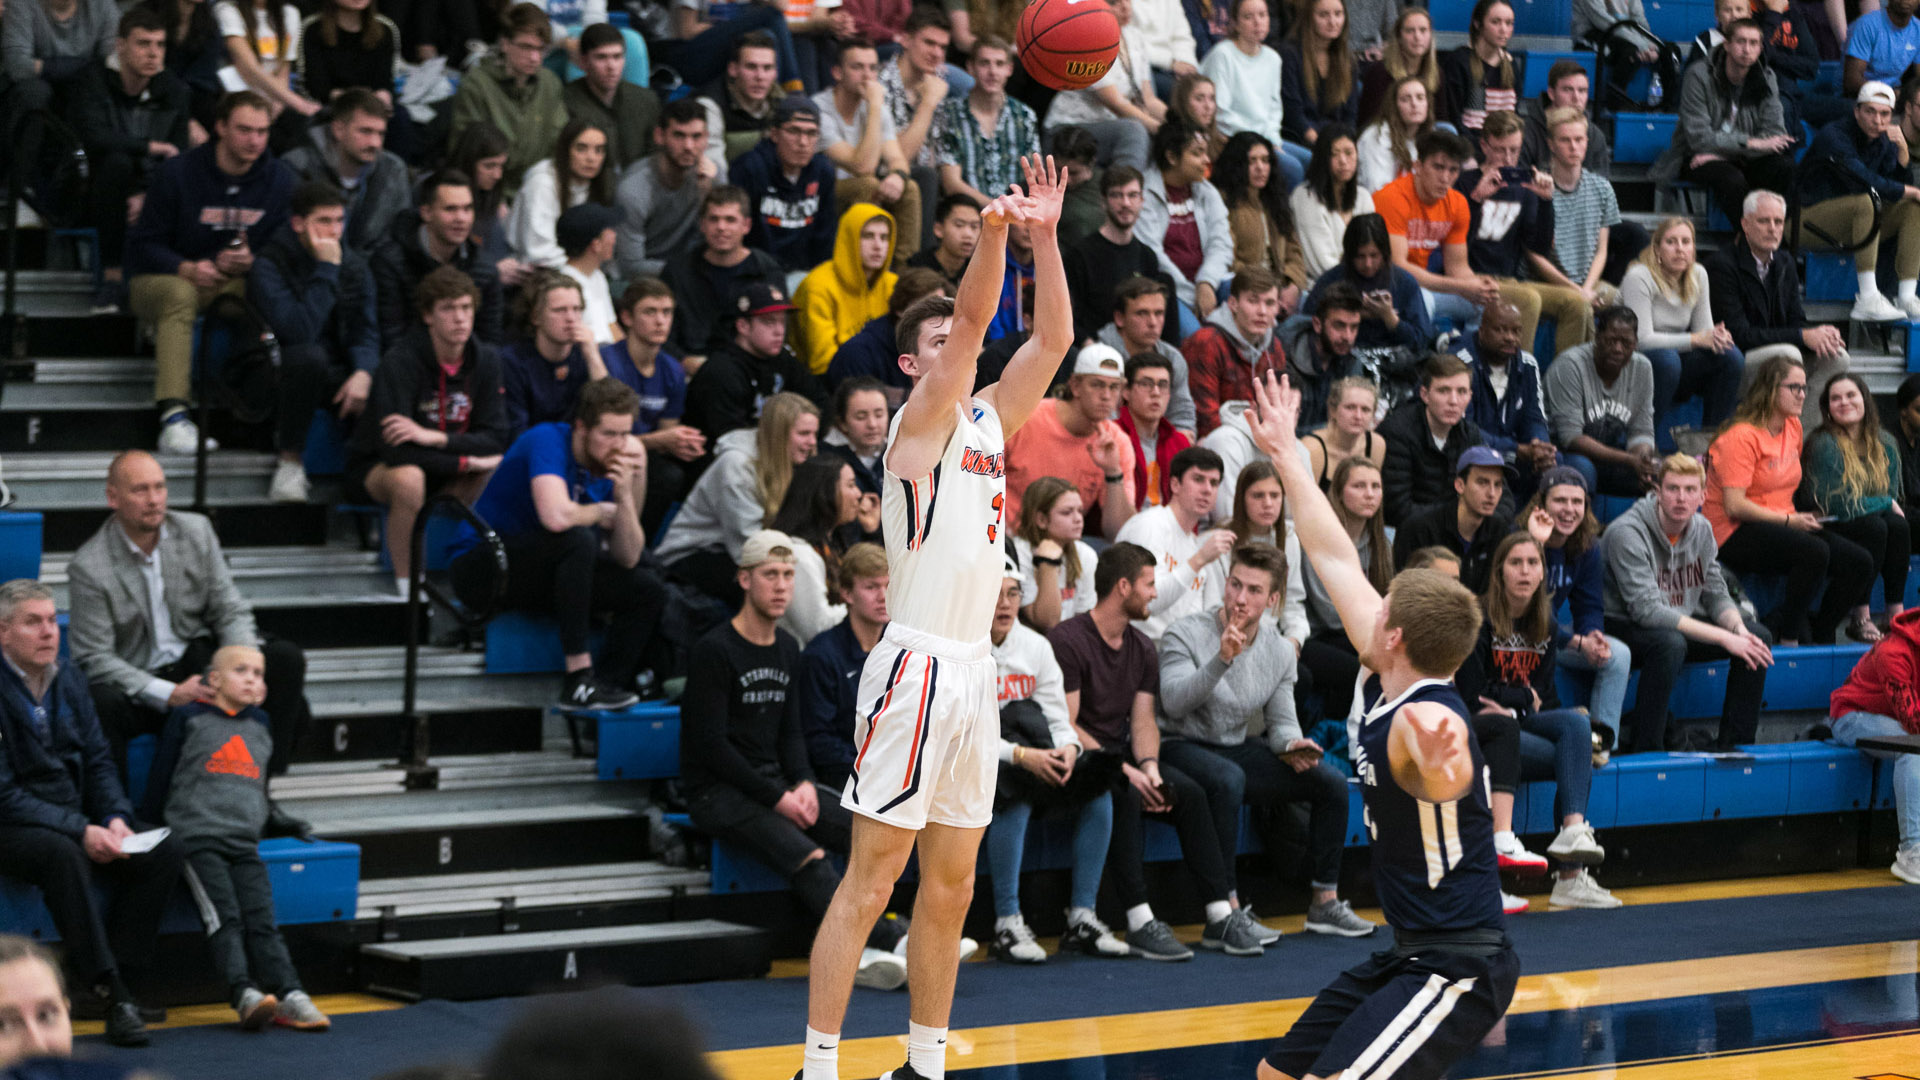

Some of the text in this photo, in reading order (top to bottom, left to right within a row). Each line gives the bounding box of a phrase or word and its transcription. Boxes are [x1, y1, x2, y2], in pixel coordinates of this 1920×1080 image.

[29, 418, 40, 443] F
[335, 723, 348, 751] C
[439, 837, 452, 864] B
[563, 951, 578, 979] A
